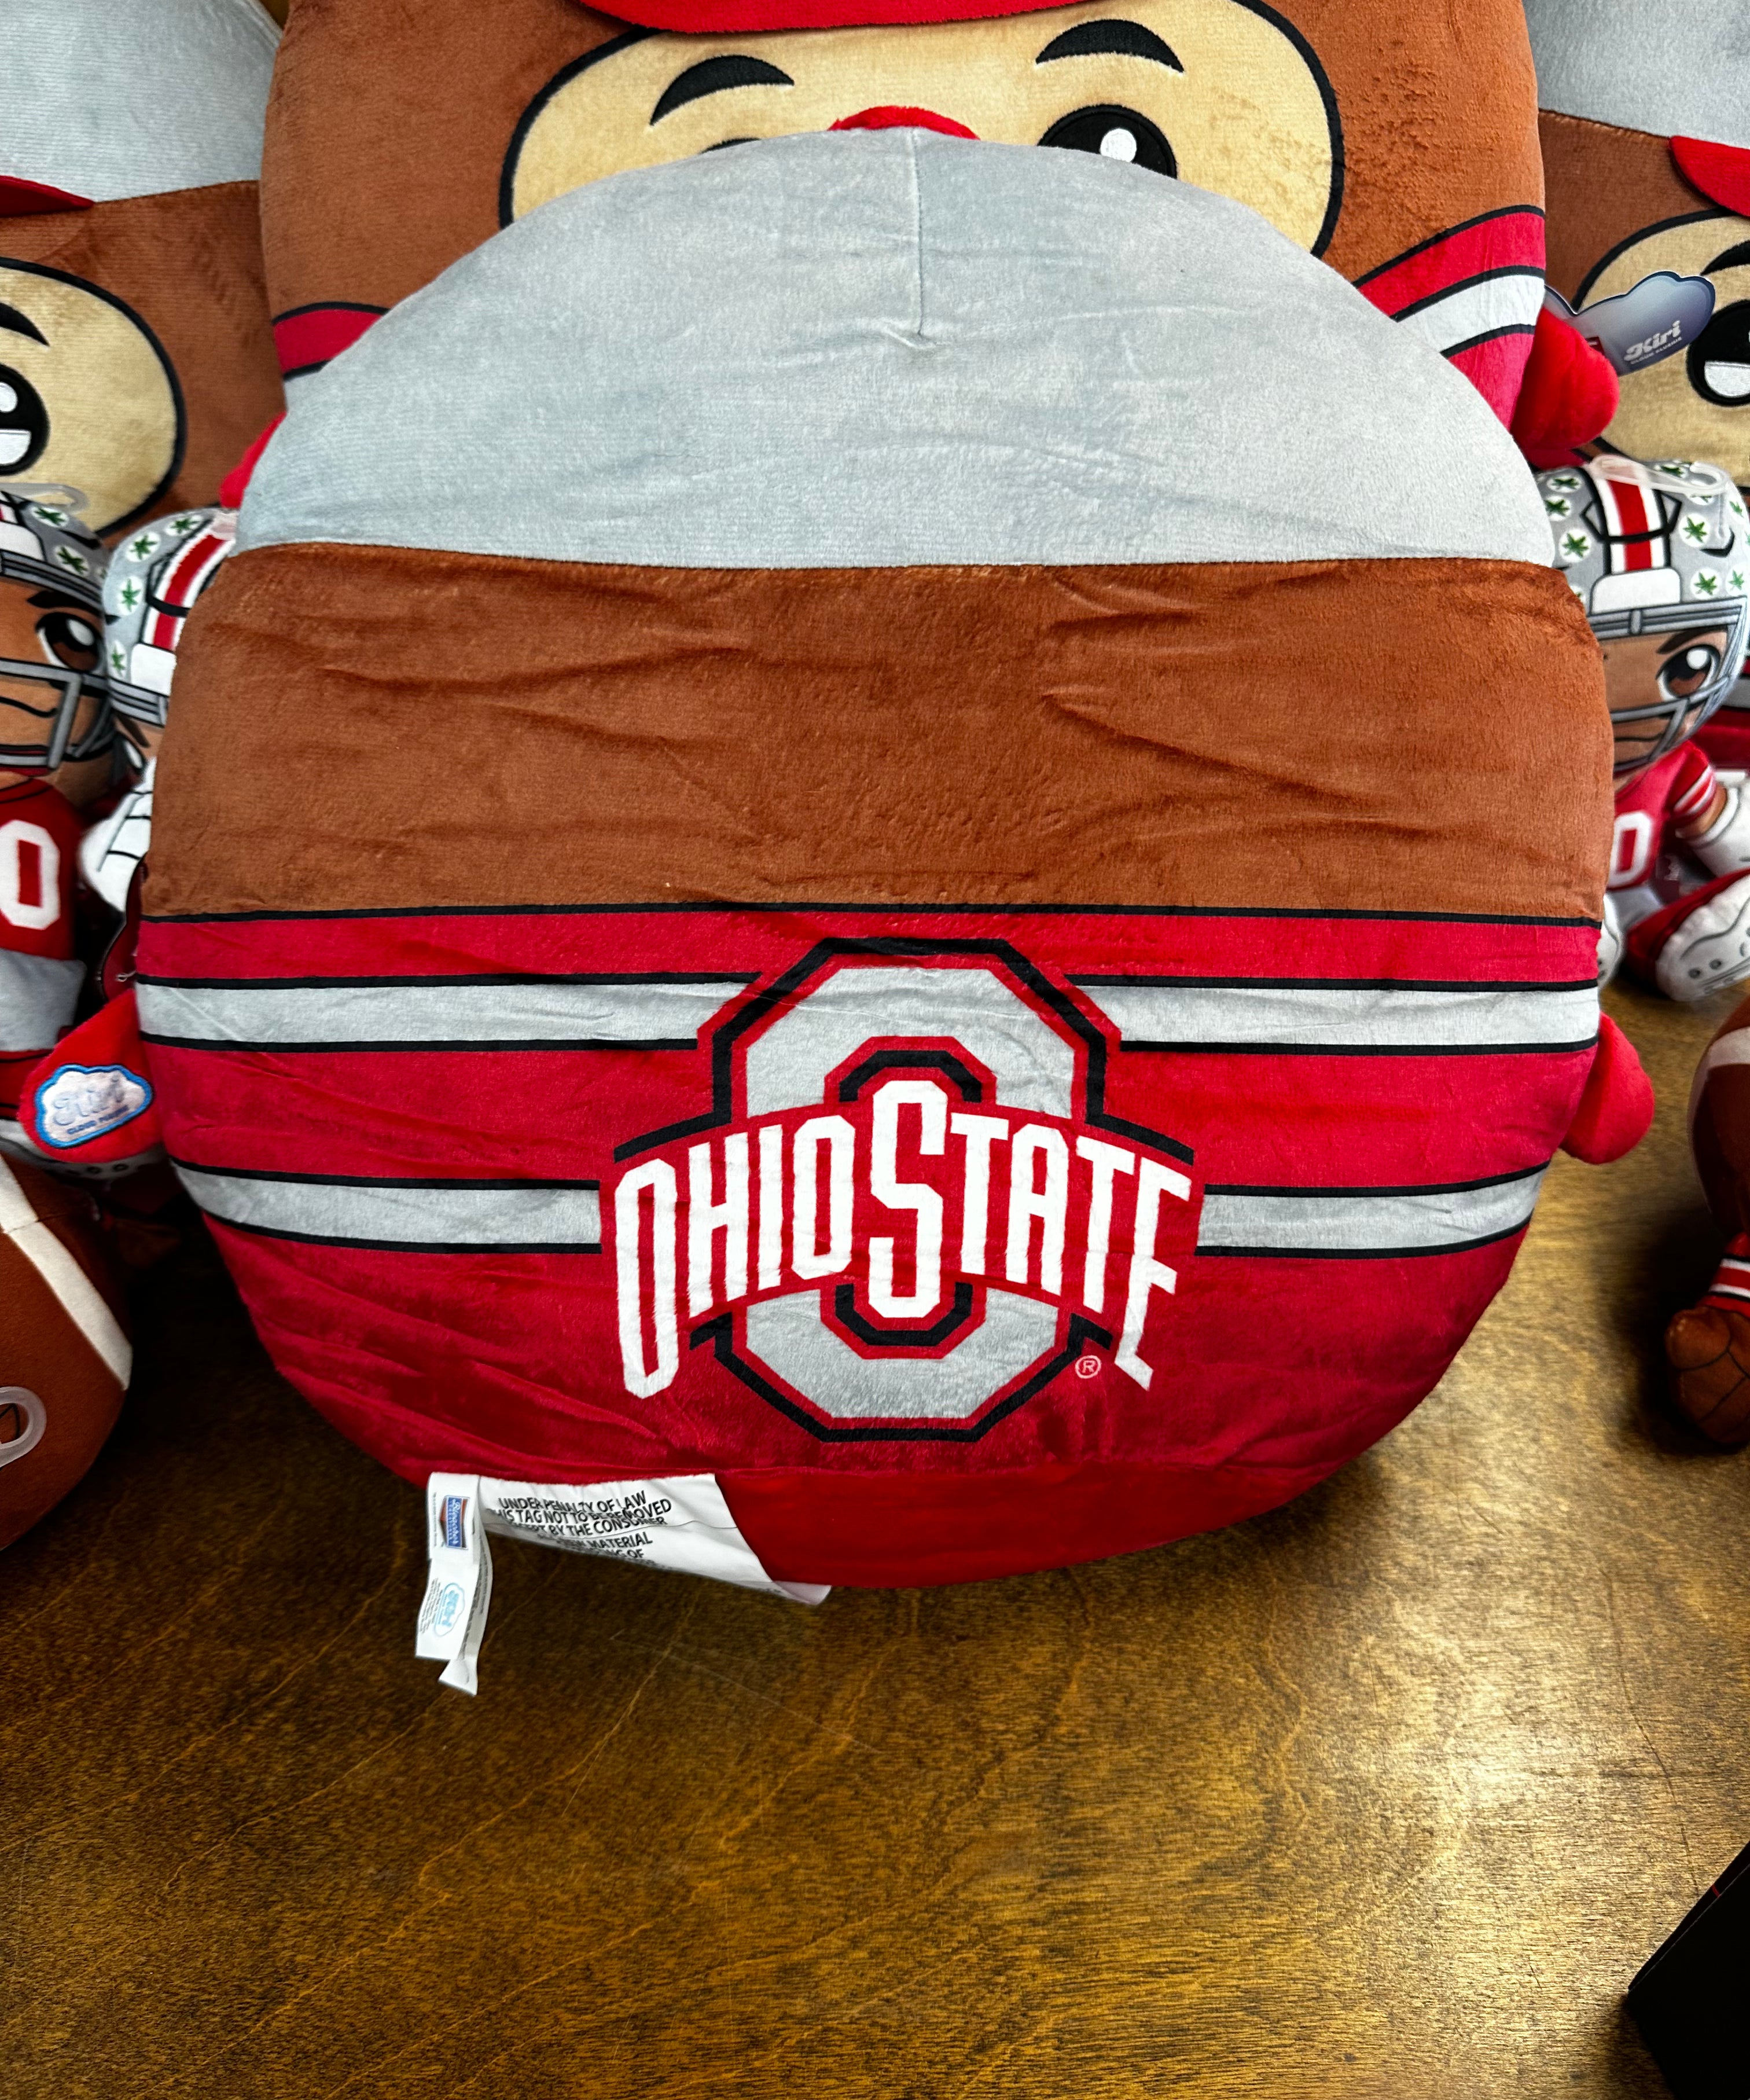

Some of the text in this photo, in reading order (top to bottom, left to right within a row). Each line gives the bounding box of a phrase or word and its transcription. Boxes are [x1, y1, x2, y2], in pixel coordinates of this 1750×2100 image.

[614, 1080, 1192, 1400] OHIO STATE
[498, 1490, 646, 1513] UNDER PENALTY OF LAW
[516, 1510, 542, 1523] TAG
[543, 1510, 569, 1523] NOT
[570, 1511, 588, 1523] TO
[549, 1525, 565, 1536] BY
[566, 1523, 593, 1536] THE
[593, 1516, 668, 1534] CONSUMER
[587, 1531, 653, 1548] MATERIAL
[627, 1548, 644, 1558] OF
